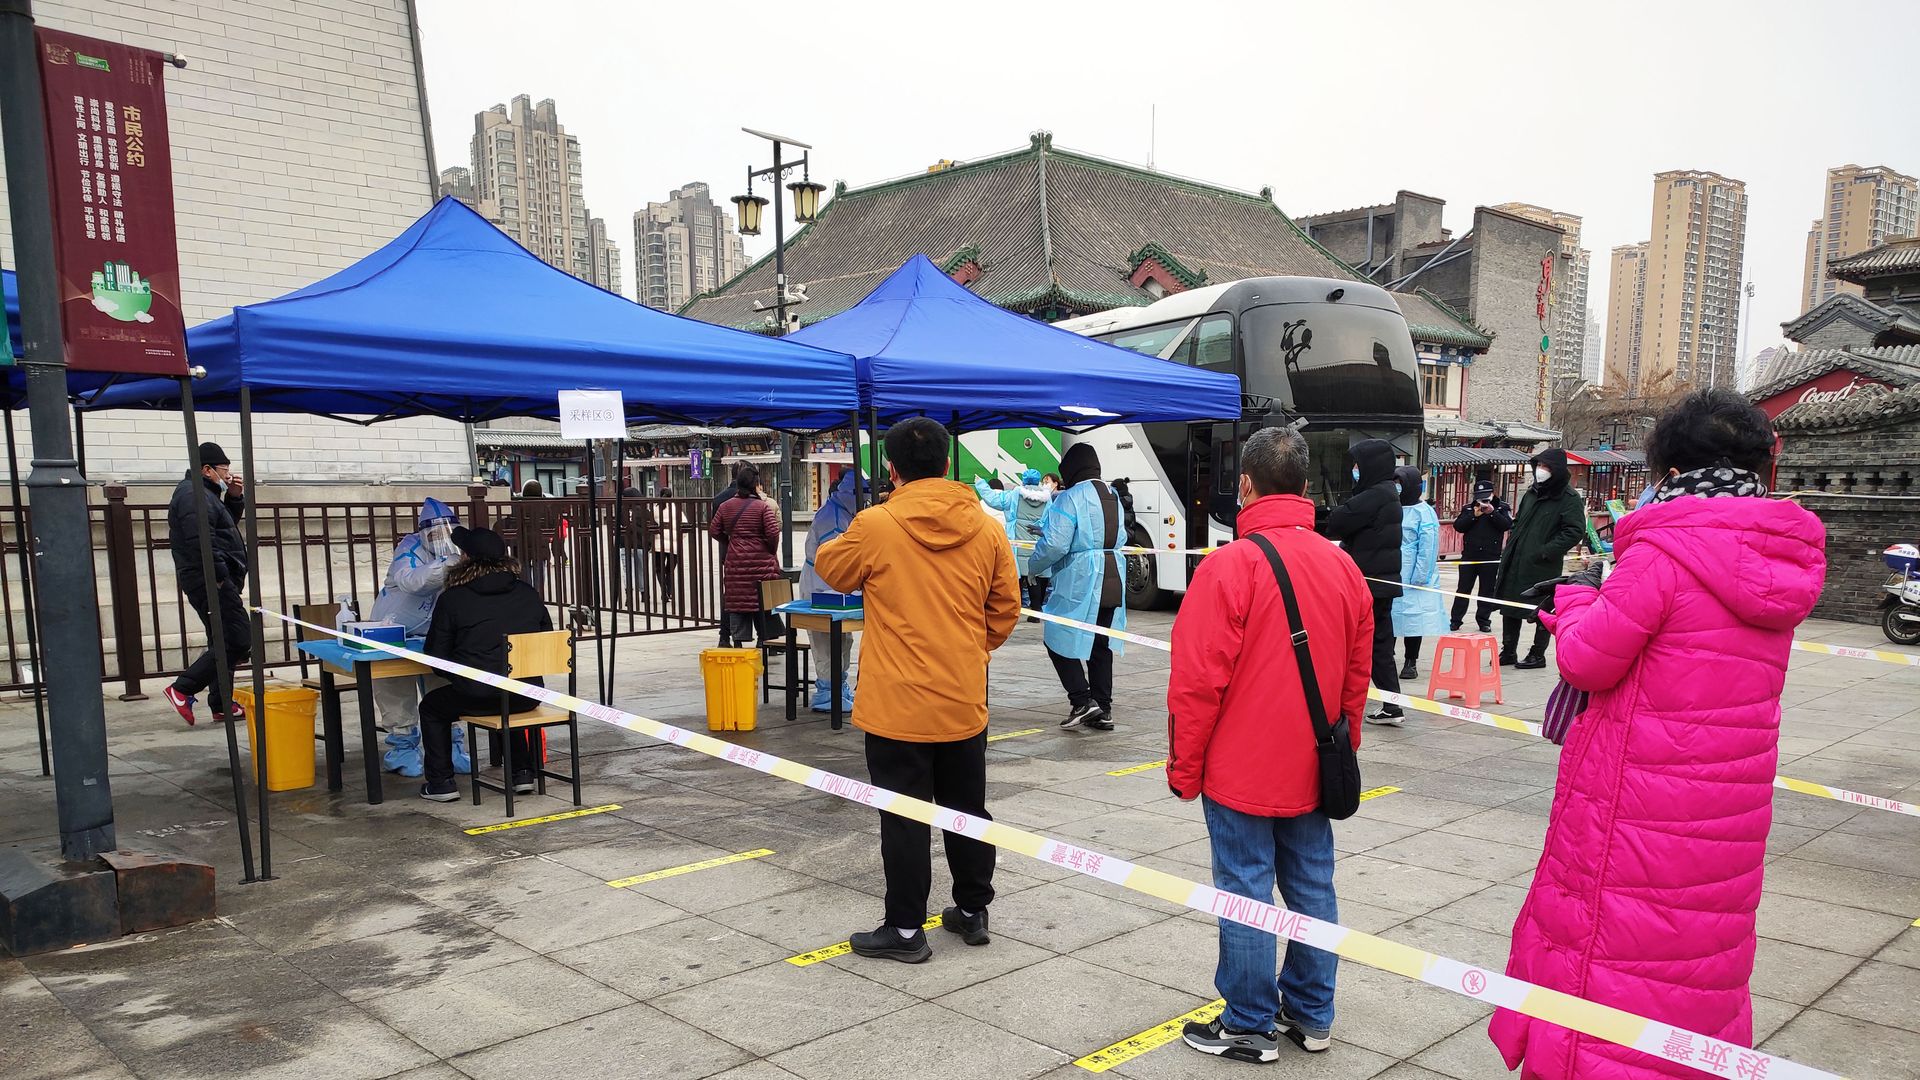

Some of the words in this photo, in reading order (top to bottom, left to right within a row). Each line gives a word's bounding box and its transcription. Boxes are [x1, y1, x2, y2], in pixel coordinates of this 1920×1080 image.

[74, 95, 86, 130] 理性上网
[89, 98, 101, 132] 崇尚科学
[105, 101, 117, 135] 爱党爱国
[76, 133, 89, 166] 文明出行
[92, 135, 104, 169] 重德修身
[122, 105, 145, 168] 市民公约
[107, 137, 120, 171] 敬业创新
[80, 169, 93, 203] 节俭环保
[95, 172, 108, 205] 友善助人
[83, 206, 96, 239] 平和包容
[113, 210, 126, 243] 明礼诚信
[569, 408, 615, 422] 采样区③
